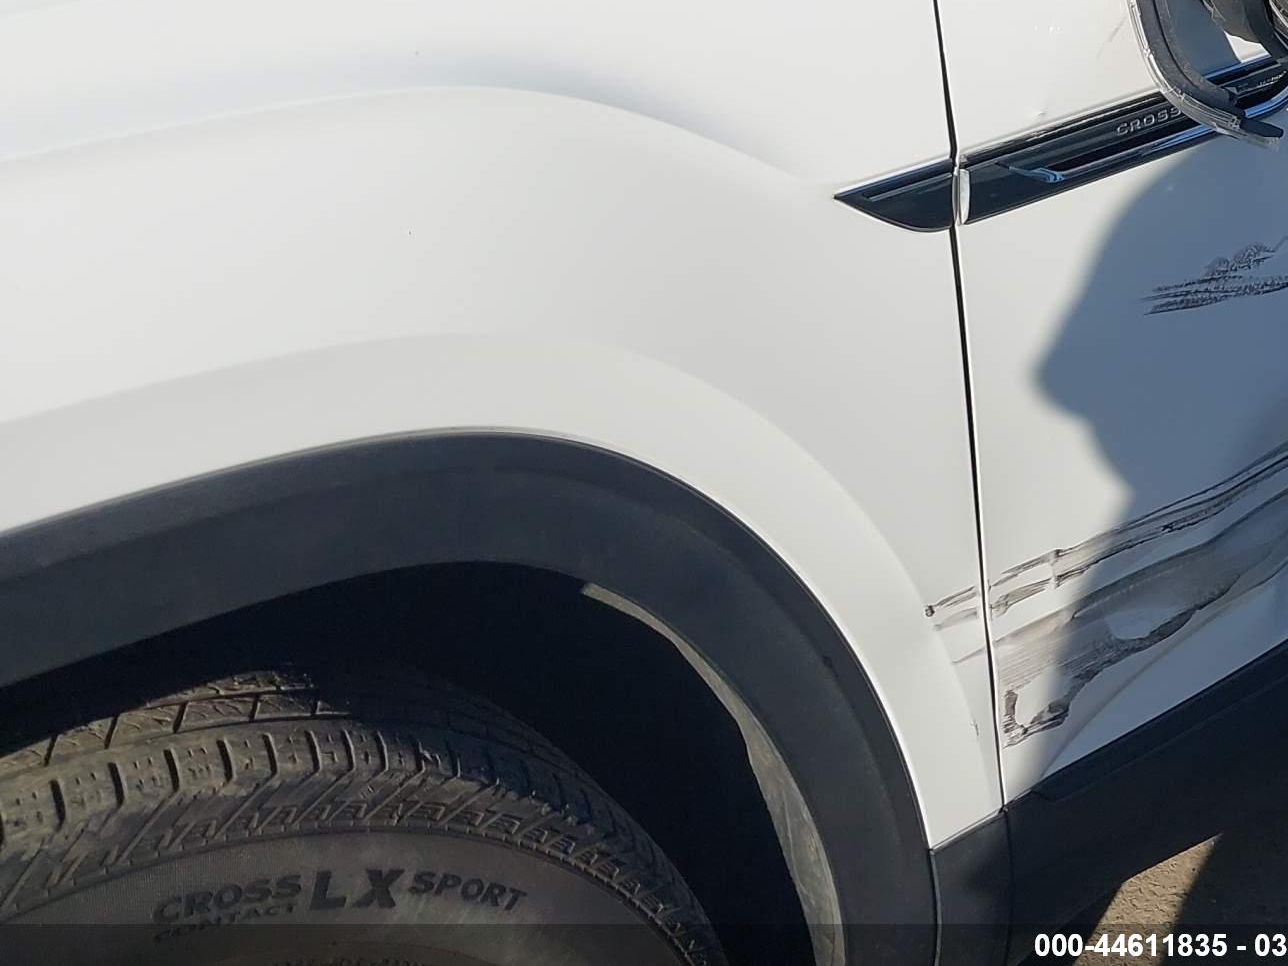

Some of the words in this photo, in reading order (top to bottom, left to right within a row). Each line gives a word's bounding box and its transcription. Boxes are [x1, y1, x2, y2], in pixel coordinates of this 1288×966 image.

[1116, 105, 1181, 136] CROSS
[152, 872, 302, 923] CROSS
[310, 868, 404, 910] LX
[411, 870, 528, 913] SPORT
[153, 905, 298, 943] CONTACT
